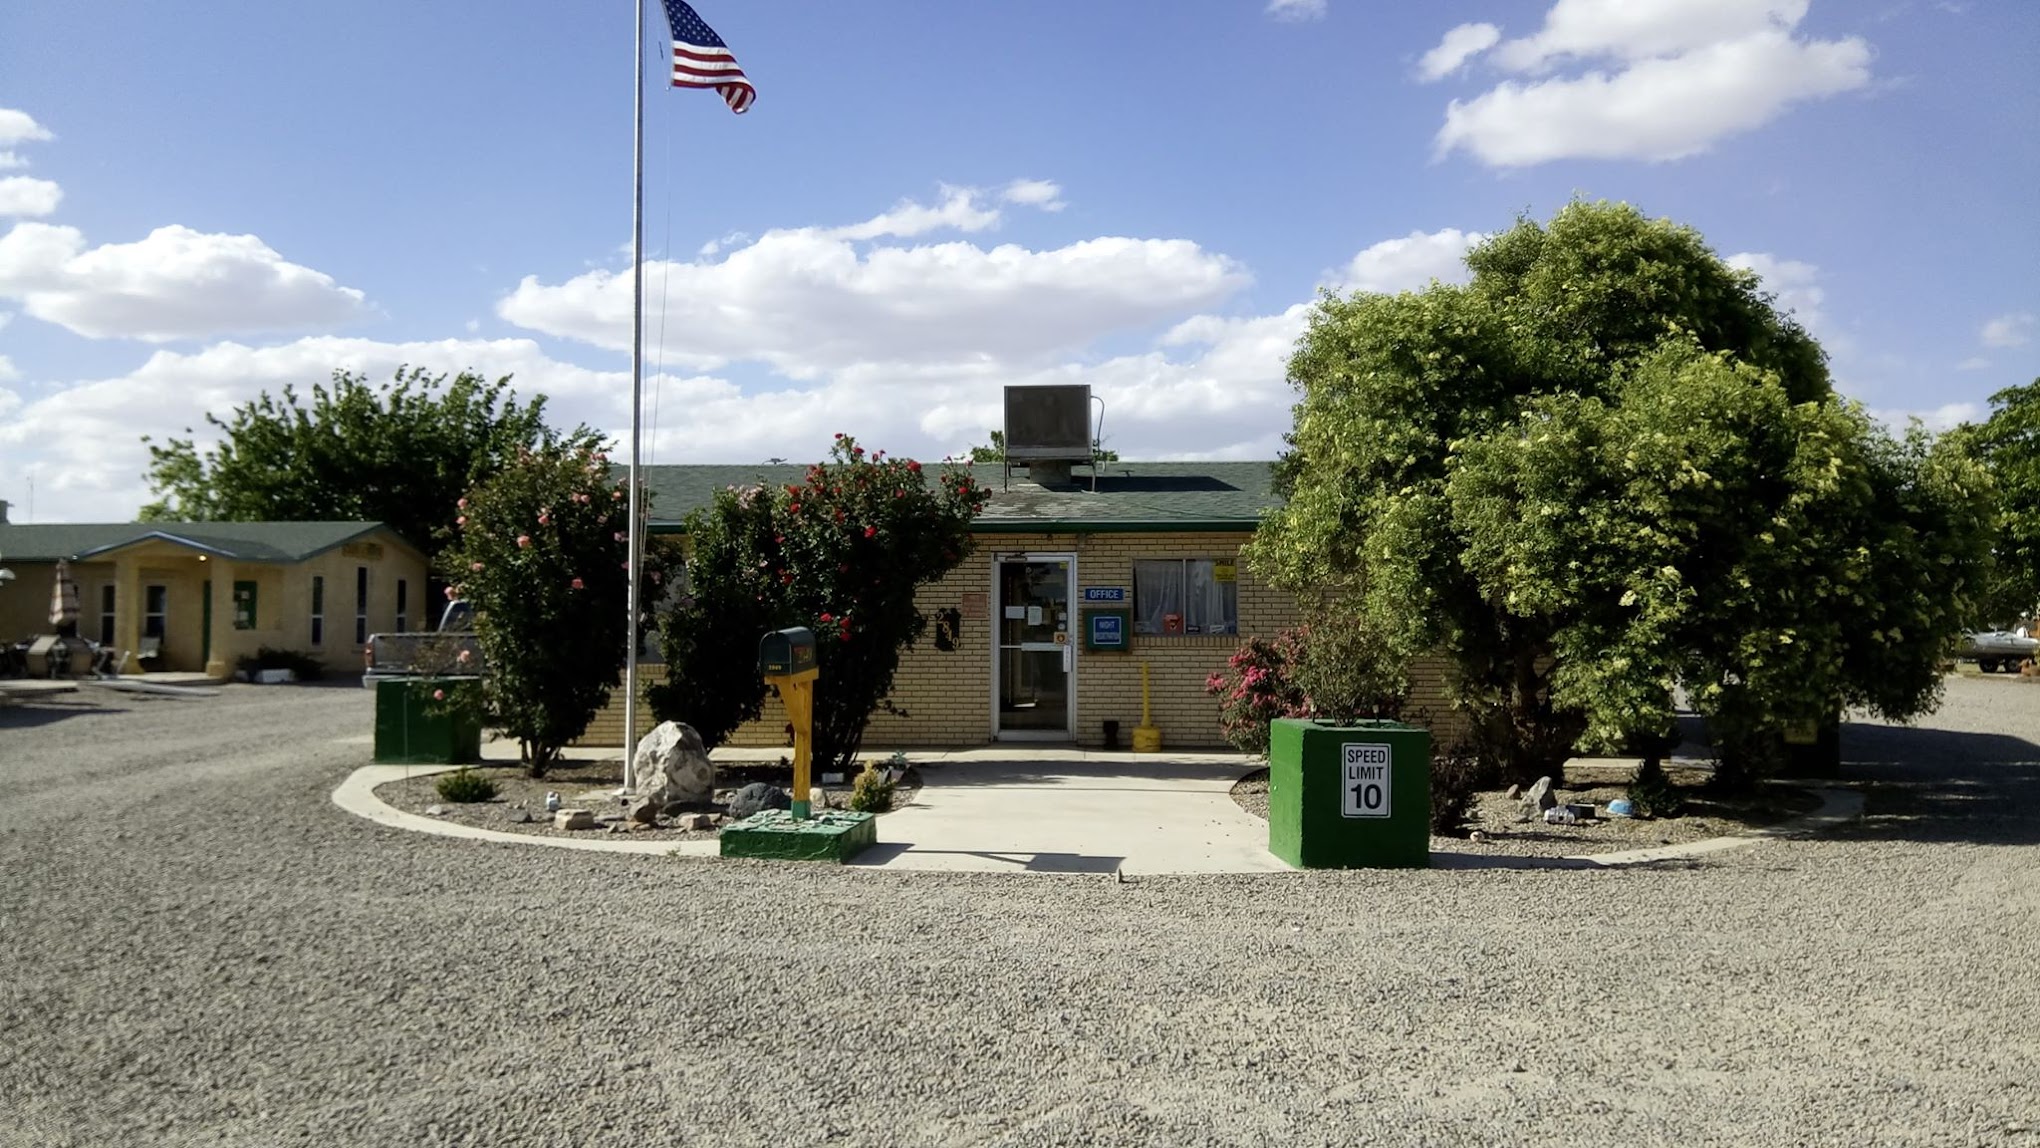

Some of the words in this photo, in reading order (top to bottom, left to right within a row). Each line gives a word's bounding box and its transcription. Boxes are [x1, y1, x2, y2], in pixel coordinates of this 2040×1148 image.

[1090, 590, 1119, 599] OFFICE
[1347, 749, 1386, 763] SPEED
[1349, 766, 1384, 780] LIMIT
[1350, 783, 1382, 810] 10
